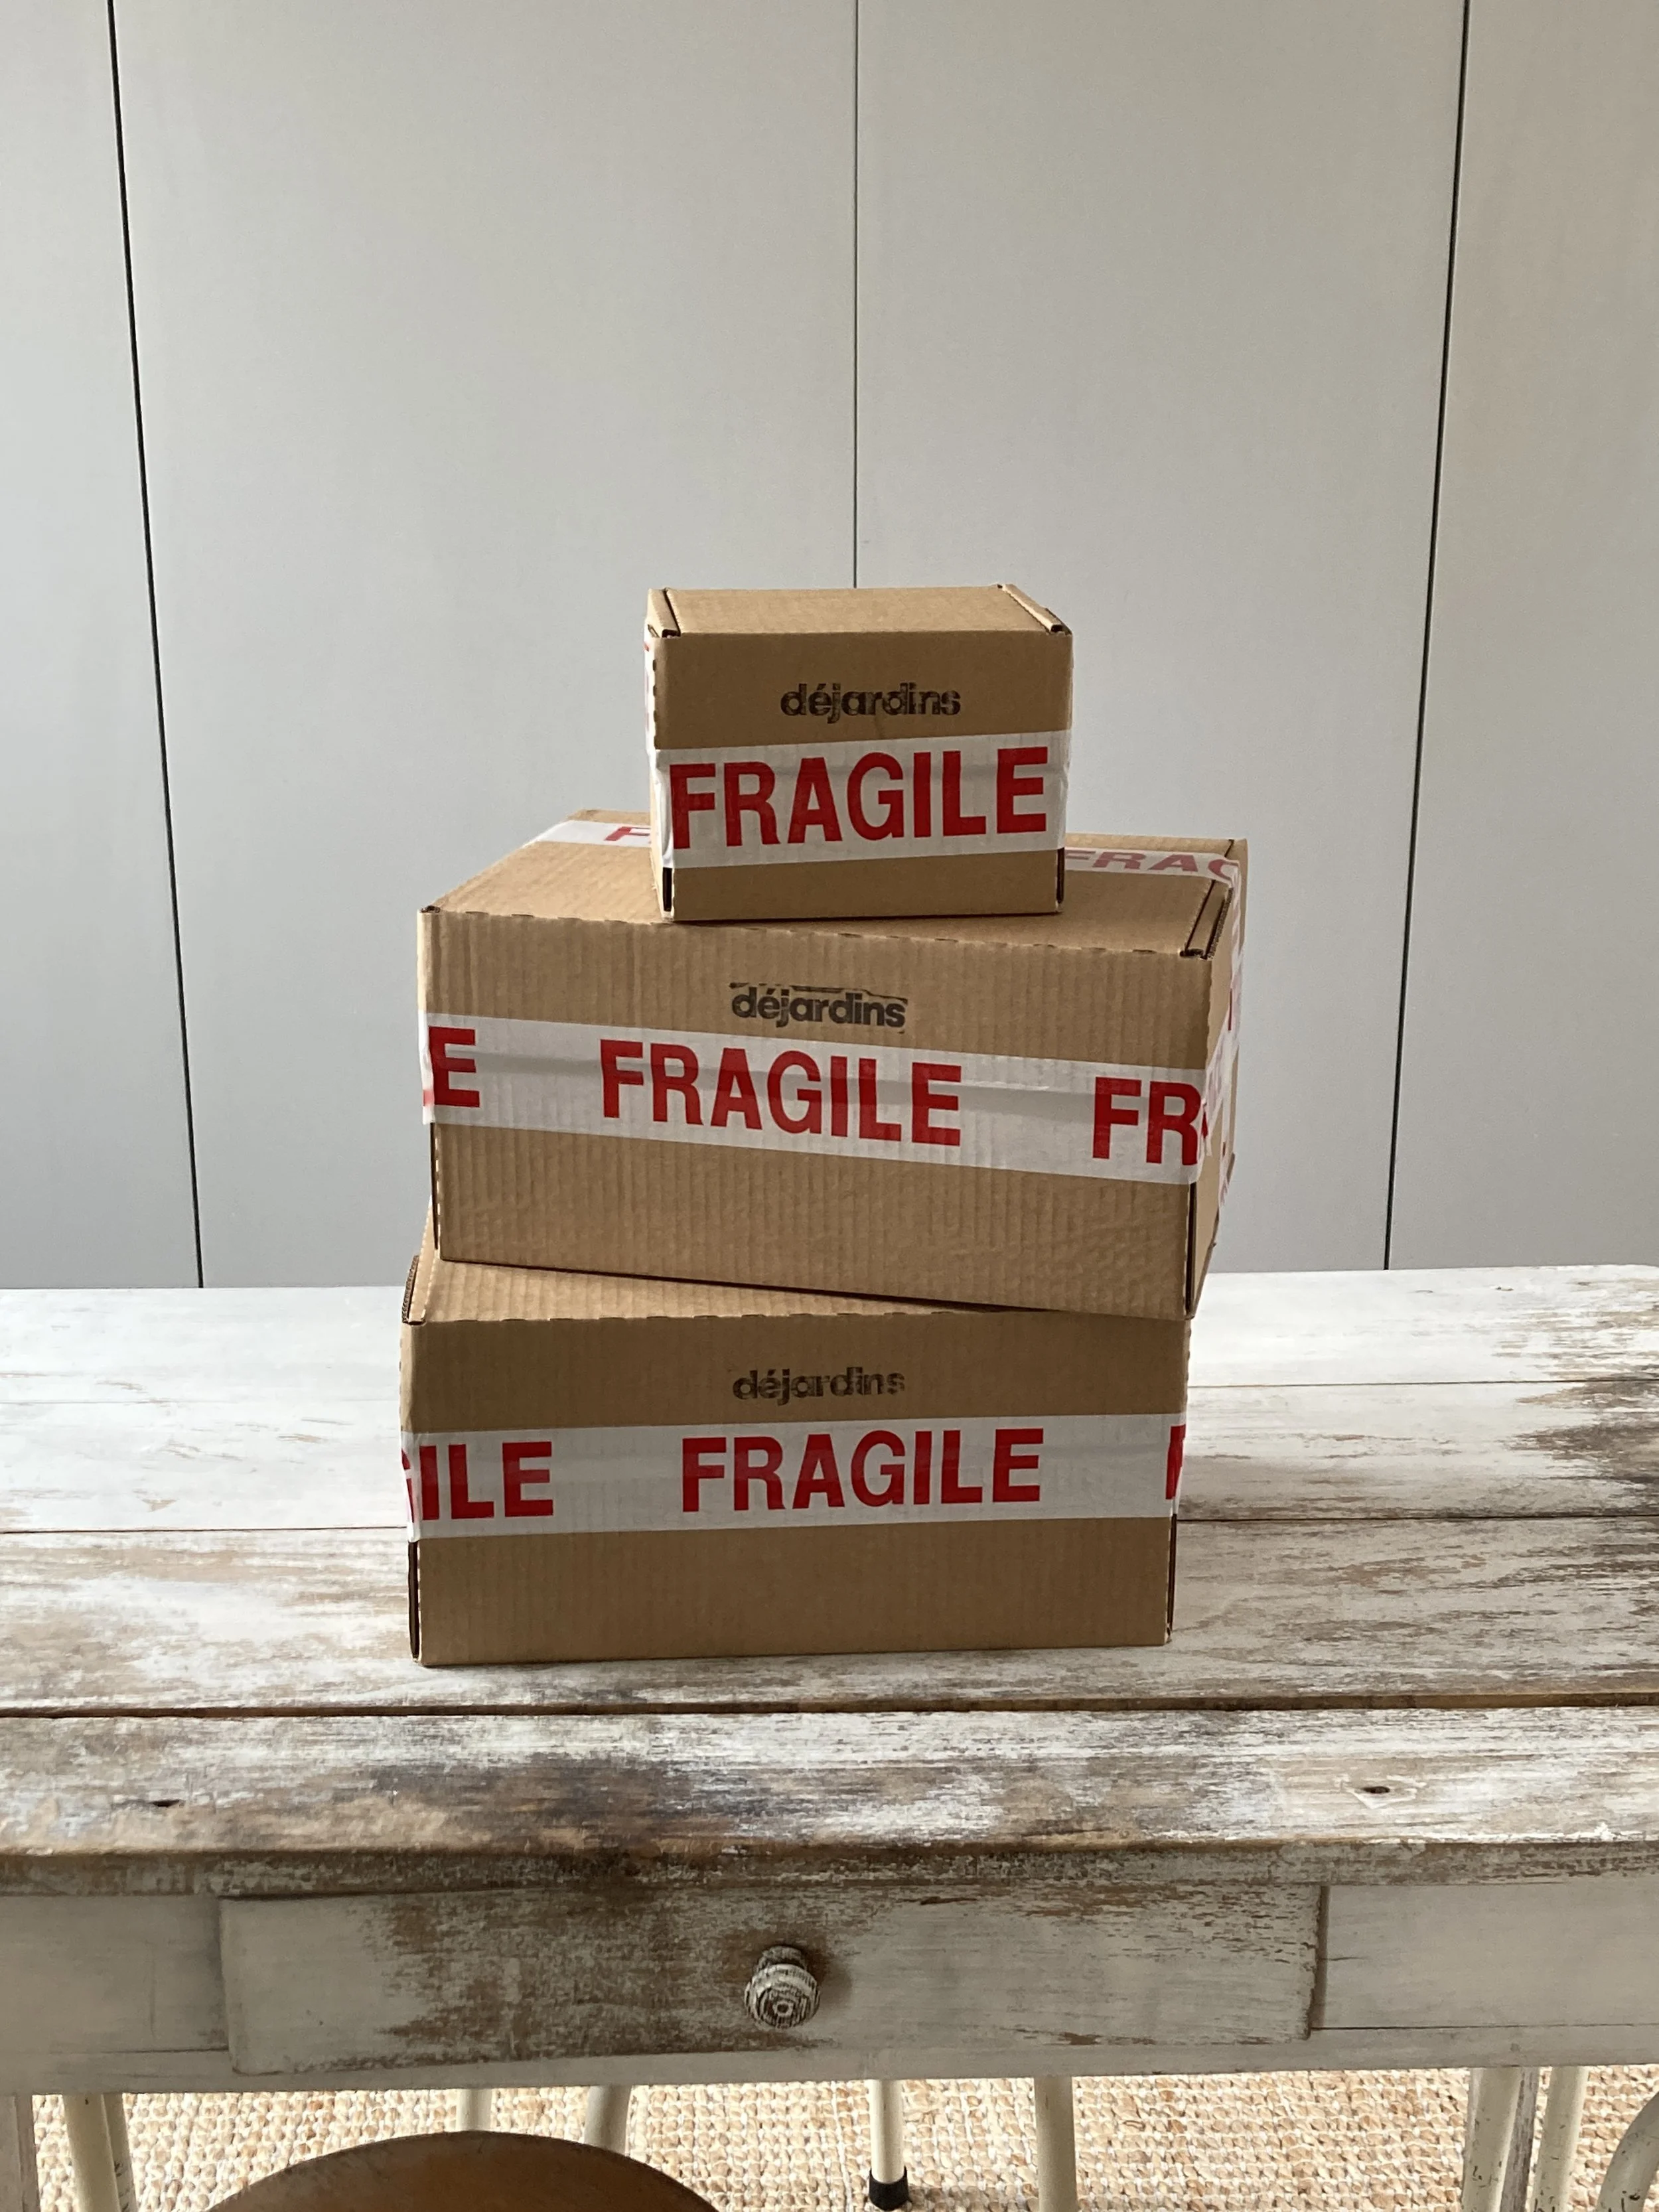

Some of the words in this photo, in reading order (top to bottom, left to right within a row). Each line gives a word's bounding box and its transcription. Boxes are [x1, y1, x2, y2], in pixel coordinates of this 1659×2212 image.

[780, 682, 962, 725] déjardins
[670, 746, 1048, 850] FRAGILE
[731, 984, 908, 1029] déjardins
[423, 1025, 480, 1108] E
[599, 1039, 962, 1146] FRAGILE
[1092, 1076, 1208, 1166] FR
[732, 1366, 905, 1406] déjardins
[401, 1441, 553, 1522] ILE
[682, 1427, 1044, 1512] FRAGILE
